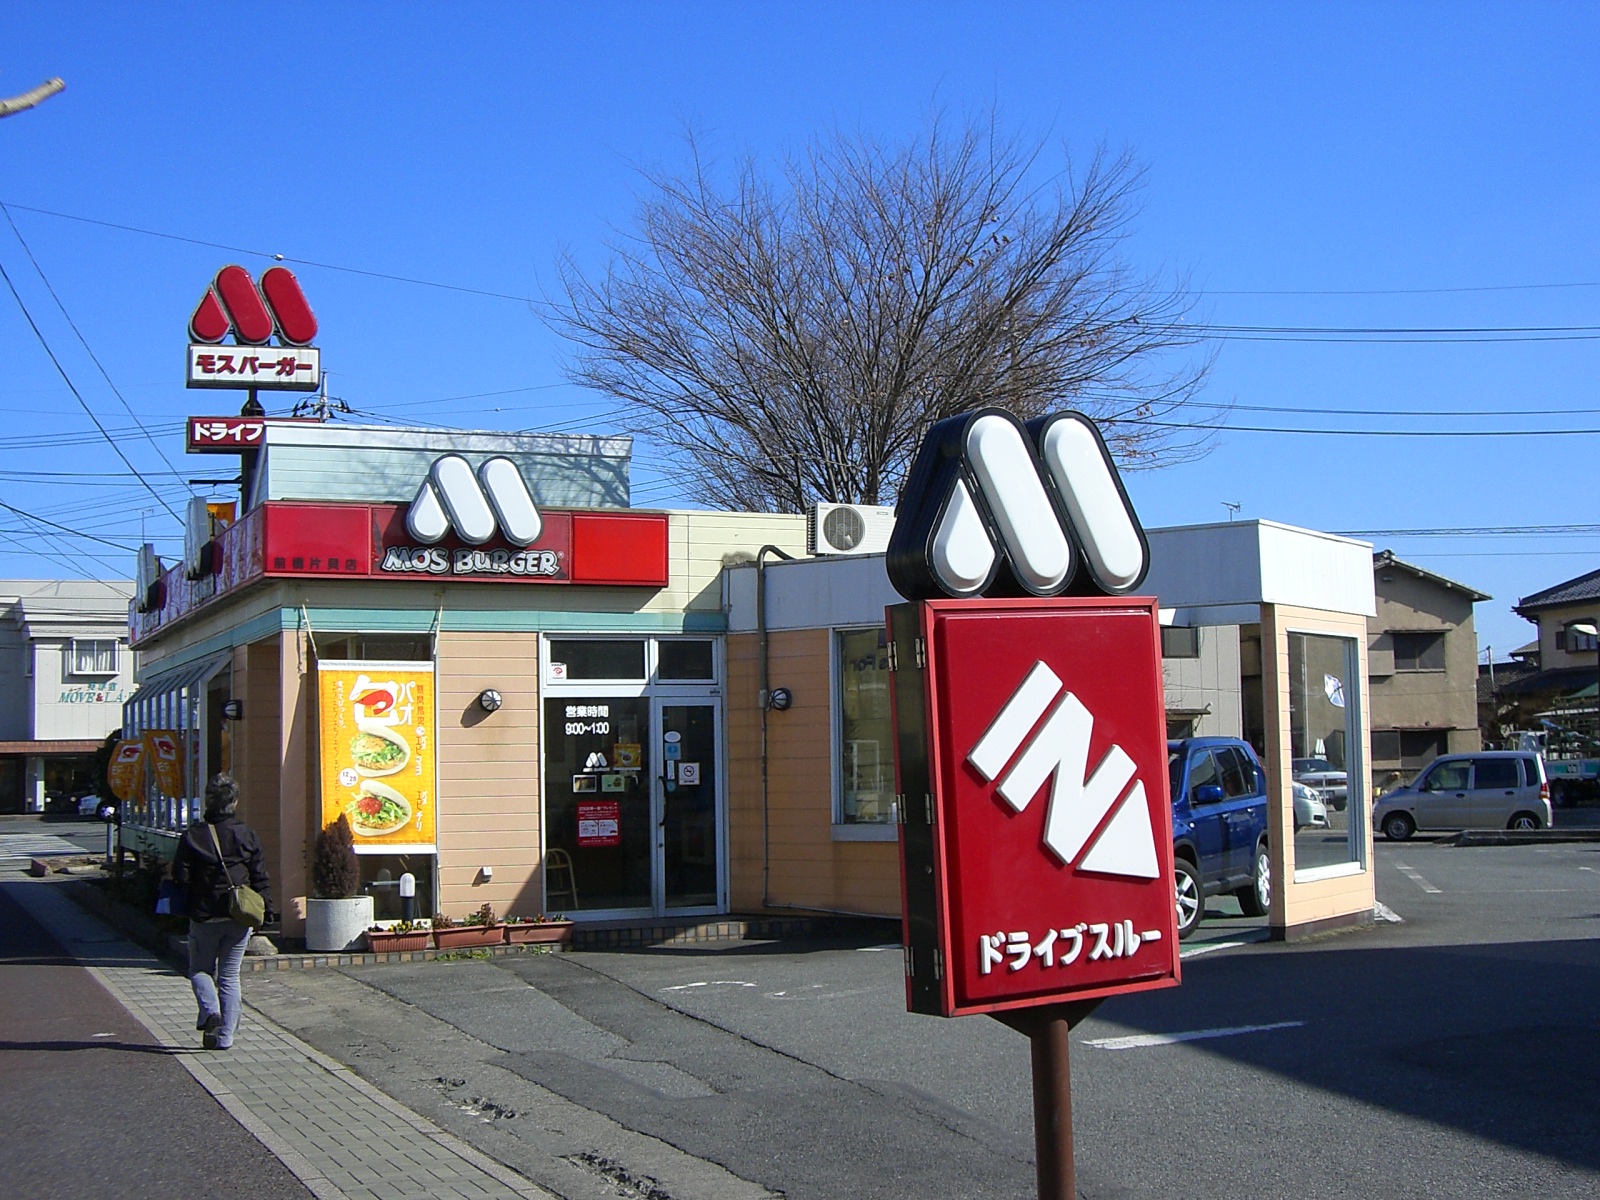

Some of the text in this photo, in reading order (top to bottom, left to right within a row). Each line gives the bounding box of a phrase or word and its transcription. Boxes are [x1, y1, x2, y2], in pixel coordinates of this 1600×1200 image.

[196, 354, 313, 376] モスバーガー
[382, 547, 560, 576] MOS BURGER
[398, 680, 416, 726] パオ
[565, 705, 609, 718] 営業時間
[967, 658, 1137, 866] IN
[980, 919, 1162, 975] ドライブスルー
